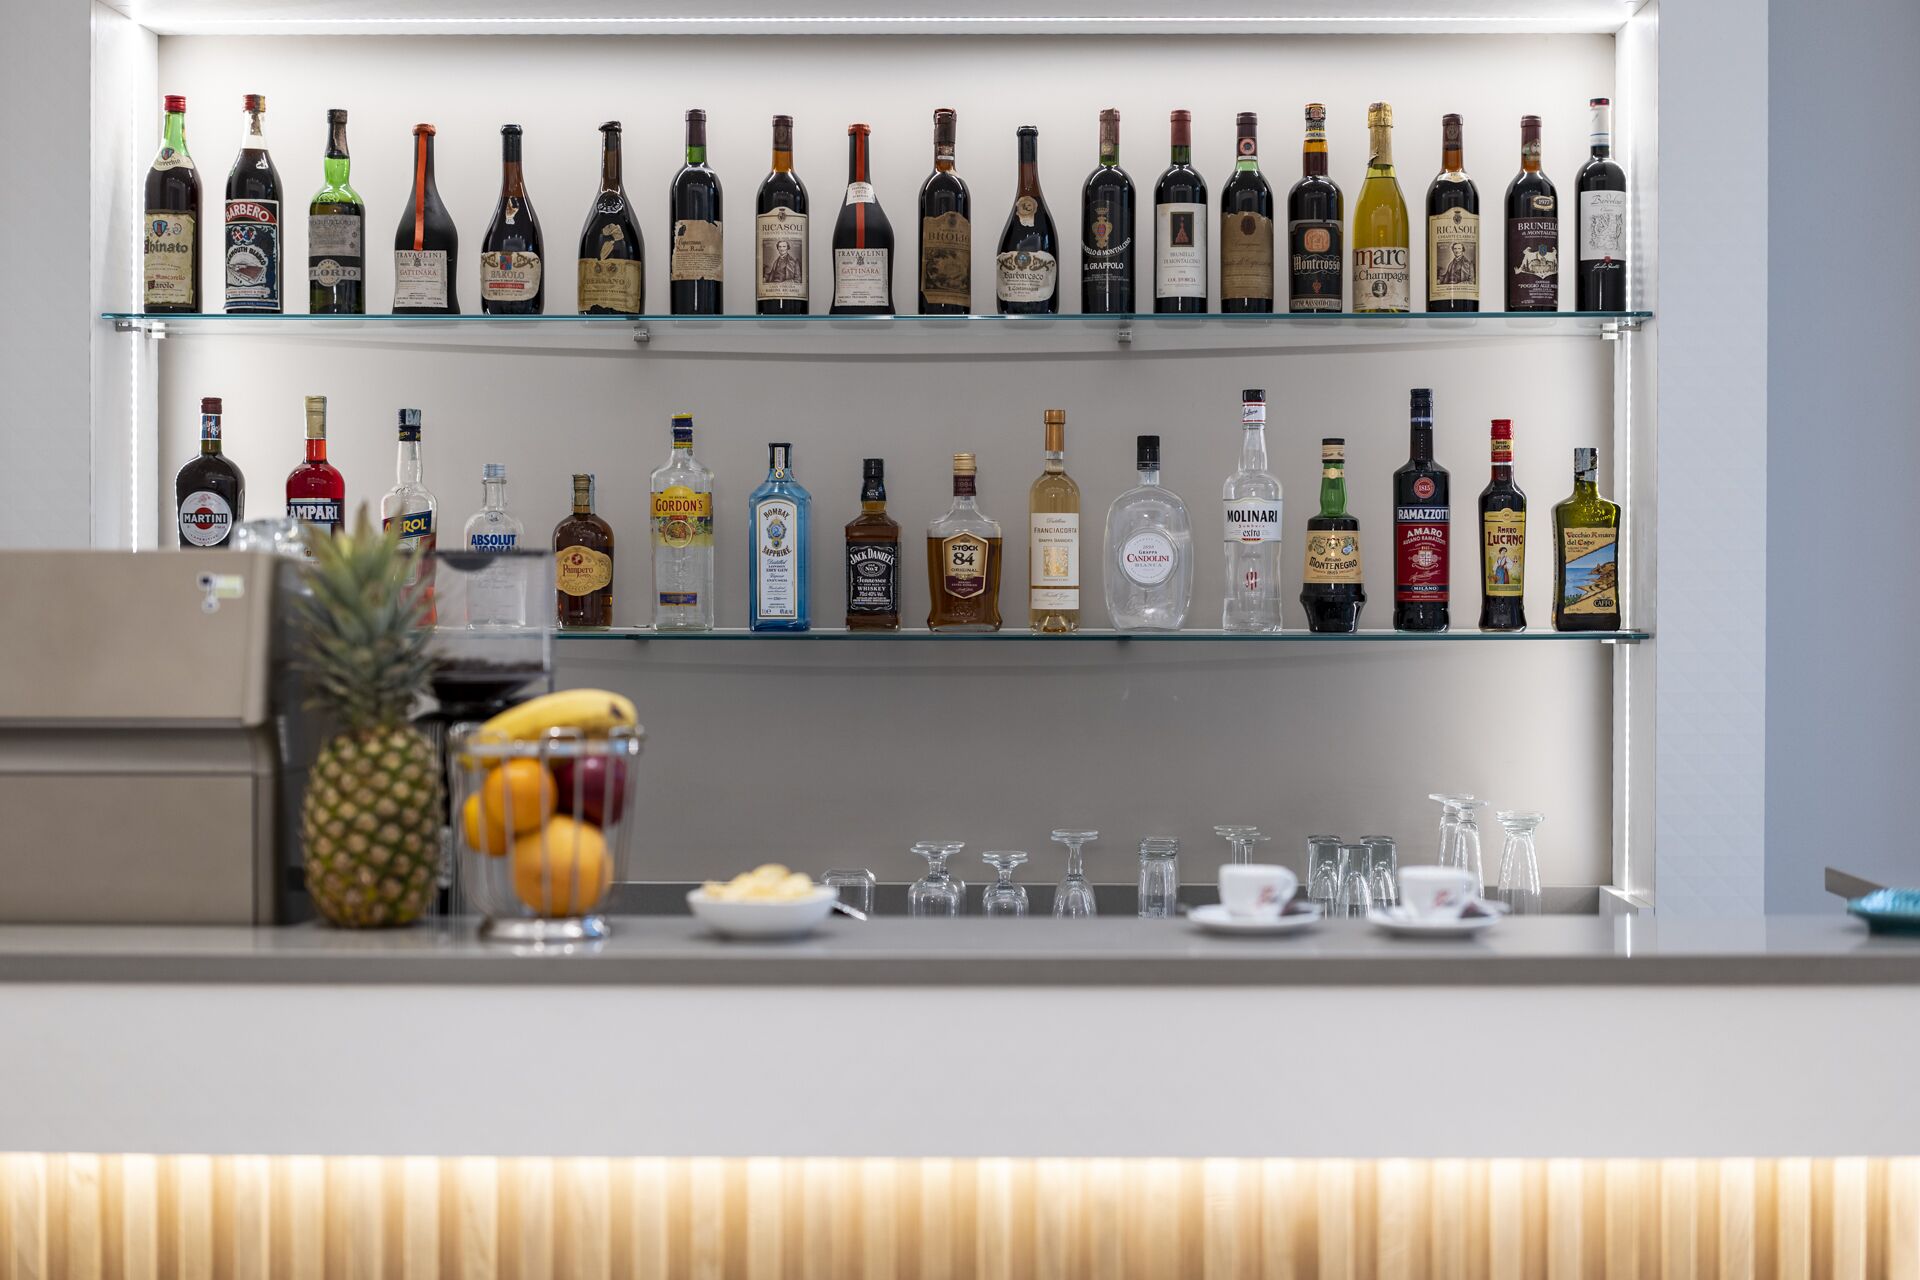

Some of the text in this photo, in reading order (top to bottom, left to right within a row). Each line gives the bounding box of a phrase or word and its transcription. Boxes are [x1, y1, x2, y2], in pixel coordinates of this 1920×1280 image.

[226, 203, 269, 222] BARBERO
[762, 223, 803, 232] RICASOLI
[1437, 226, 1477, 235] RICASOLI
[1356, 249, 1407, 269] marc
[1089, 262, 1124, 270] GRAPPOLO
[490, 270, 525, 279] BAROLO
[656, 498, 703, 512] GORDON'S
[184, 514, 226, 523] MARTINI
[763, 507, 790, 520] BOMBAY
[1227, 510, 1278, 523] MOLINARI
[1407, 527, 1443, 538] AMARO
[1497, 526, 1517, 534] AMARO
[1566, 531, 1591, 539] Vecchio
[471, 534, 516, 546] ABSOLUT
[1487, 531, 1523, 546] LUCANO
[762, 545, 792, 557] SAPPHIRE
[952, 544, 978, 552] STOCK
[850, 548, 895, 565] JACK DANIEL'S
[953, 552, 975, 566] 84
[1127, 553, 1169, 563] CANDOLINI
[1309, 557, 1358, 570] MONTENEGRO
[562, 565, 594, 578] Pampero
